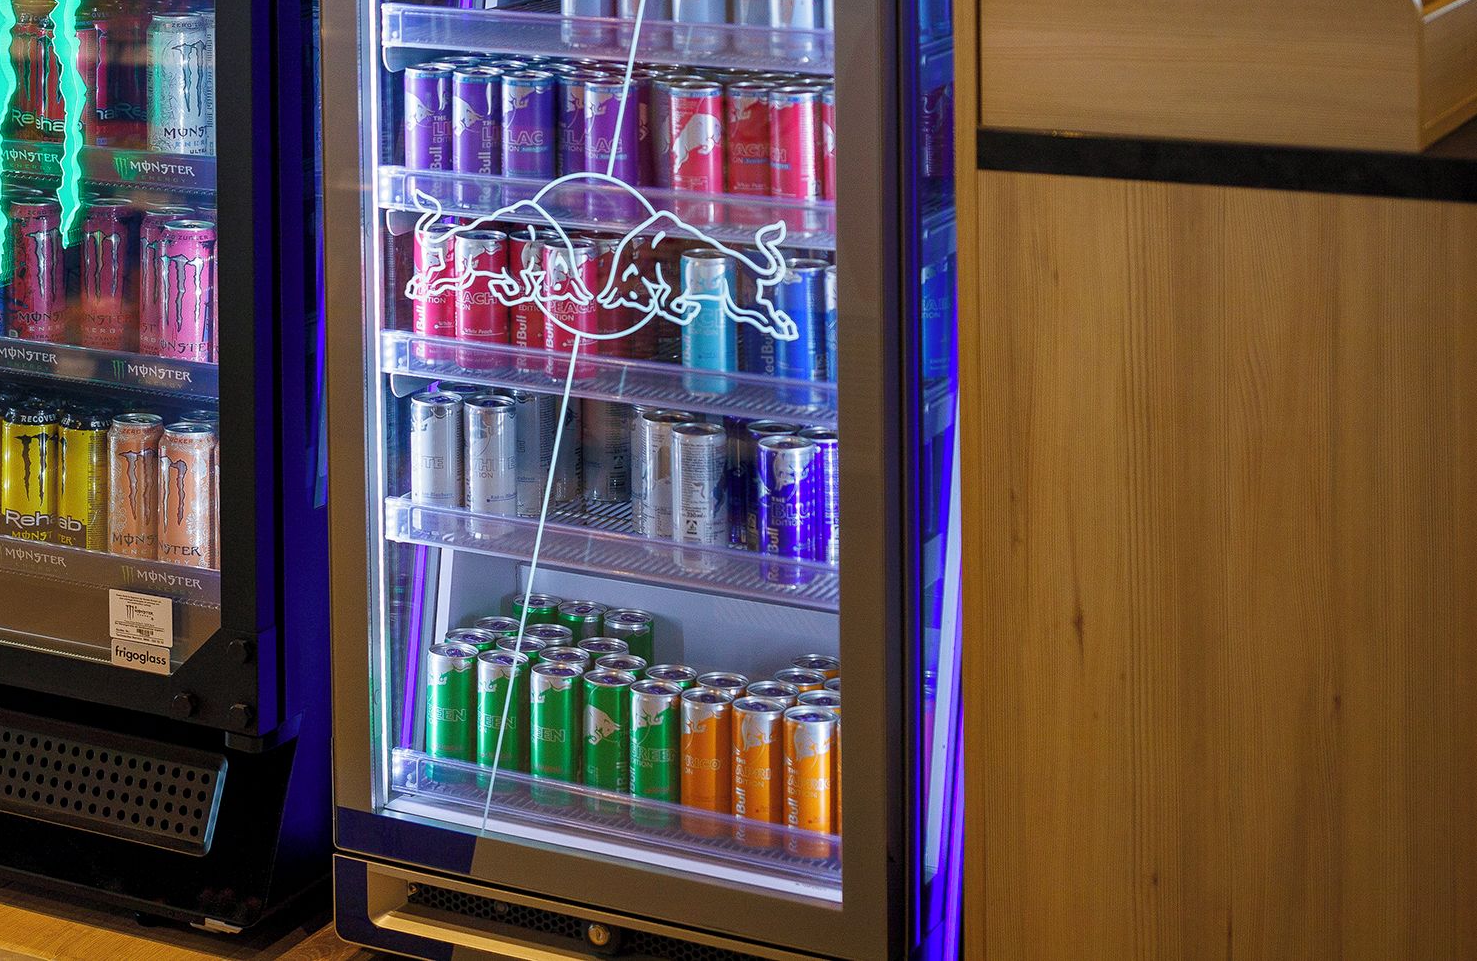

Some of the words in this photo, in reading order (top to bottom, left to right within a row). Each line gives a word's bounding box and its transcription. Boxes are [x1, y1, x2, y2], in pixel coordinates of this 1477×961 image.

[129, 159, 195, 177] MONSTER
[127, 364, 193, 383] MONSTER
[4, 546, 67, 567] MONSTER
[136, 569, 203, 590] MONSTER
[115, 645, 167, 665] frigoglass
